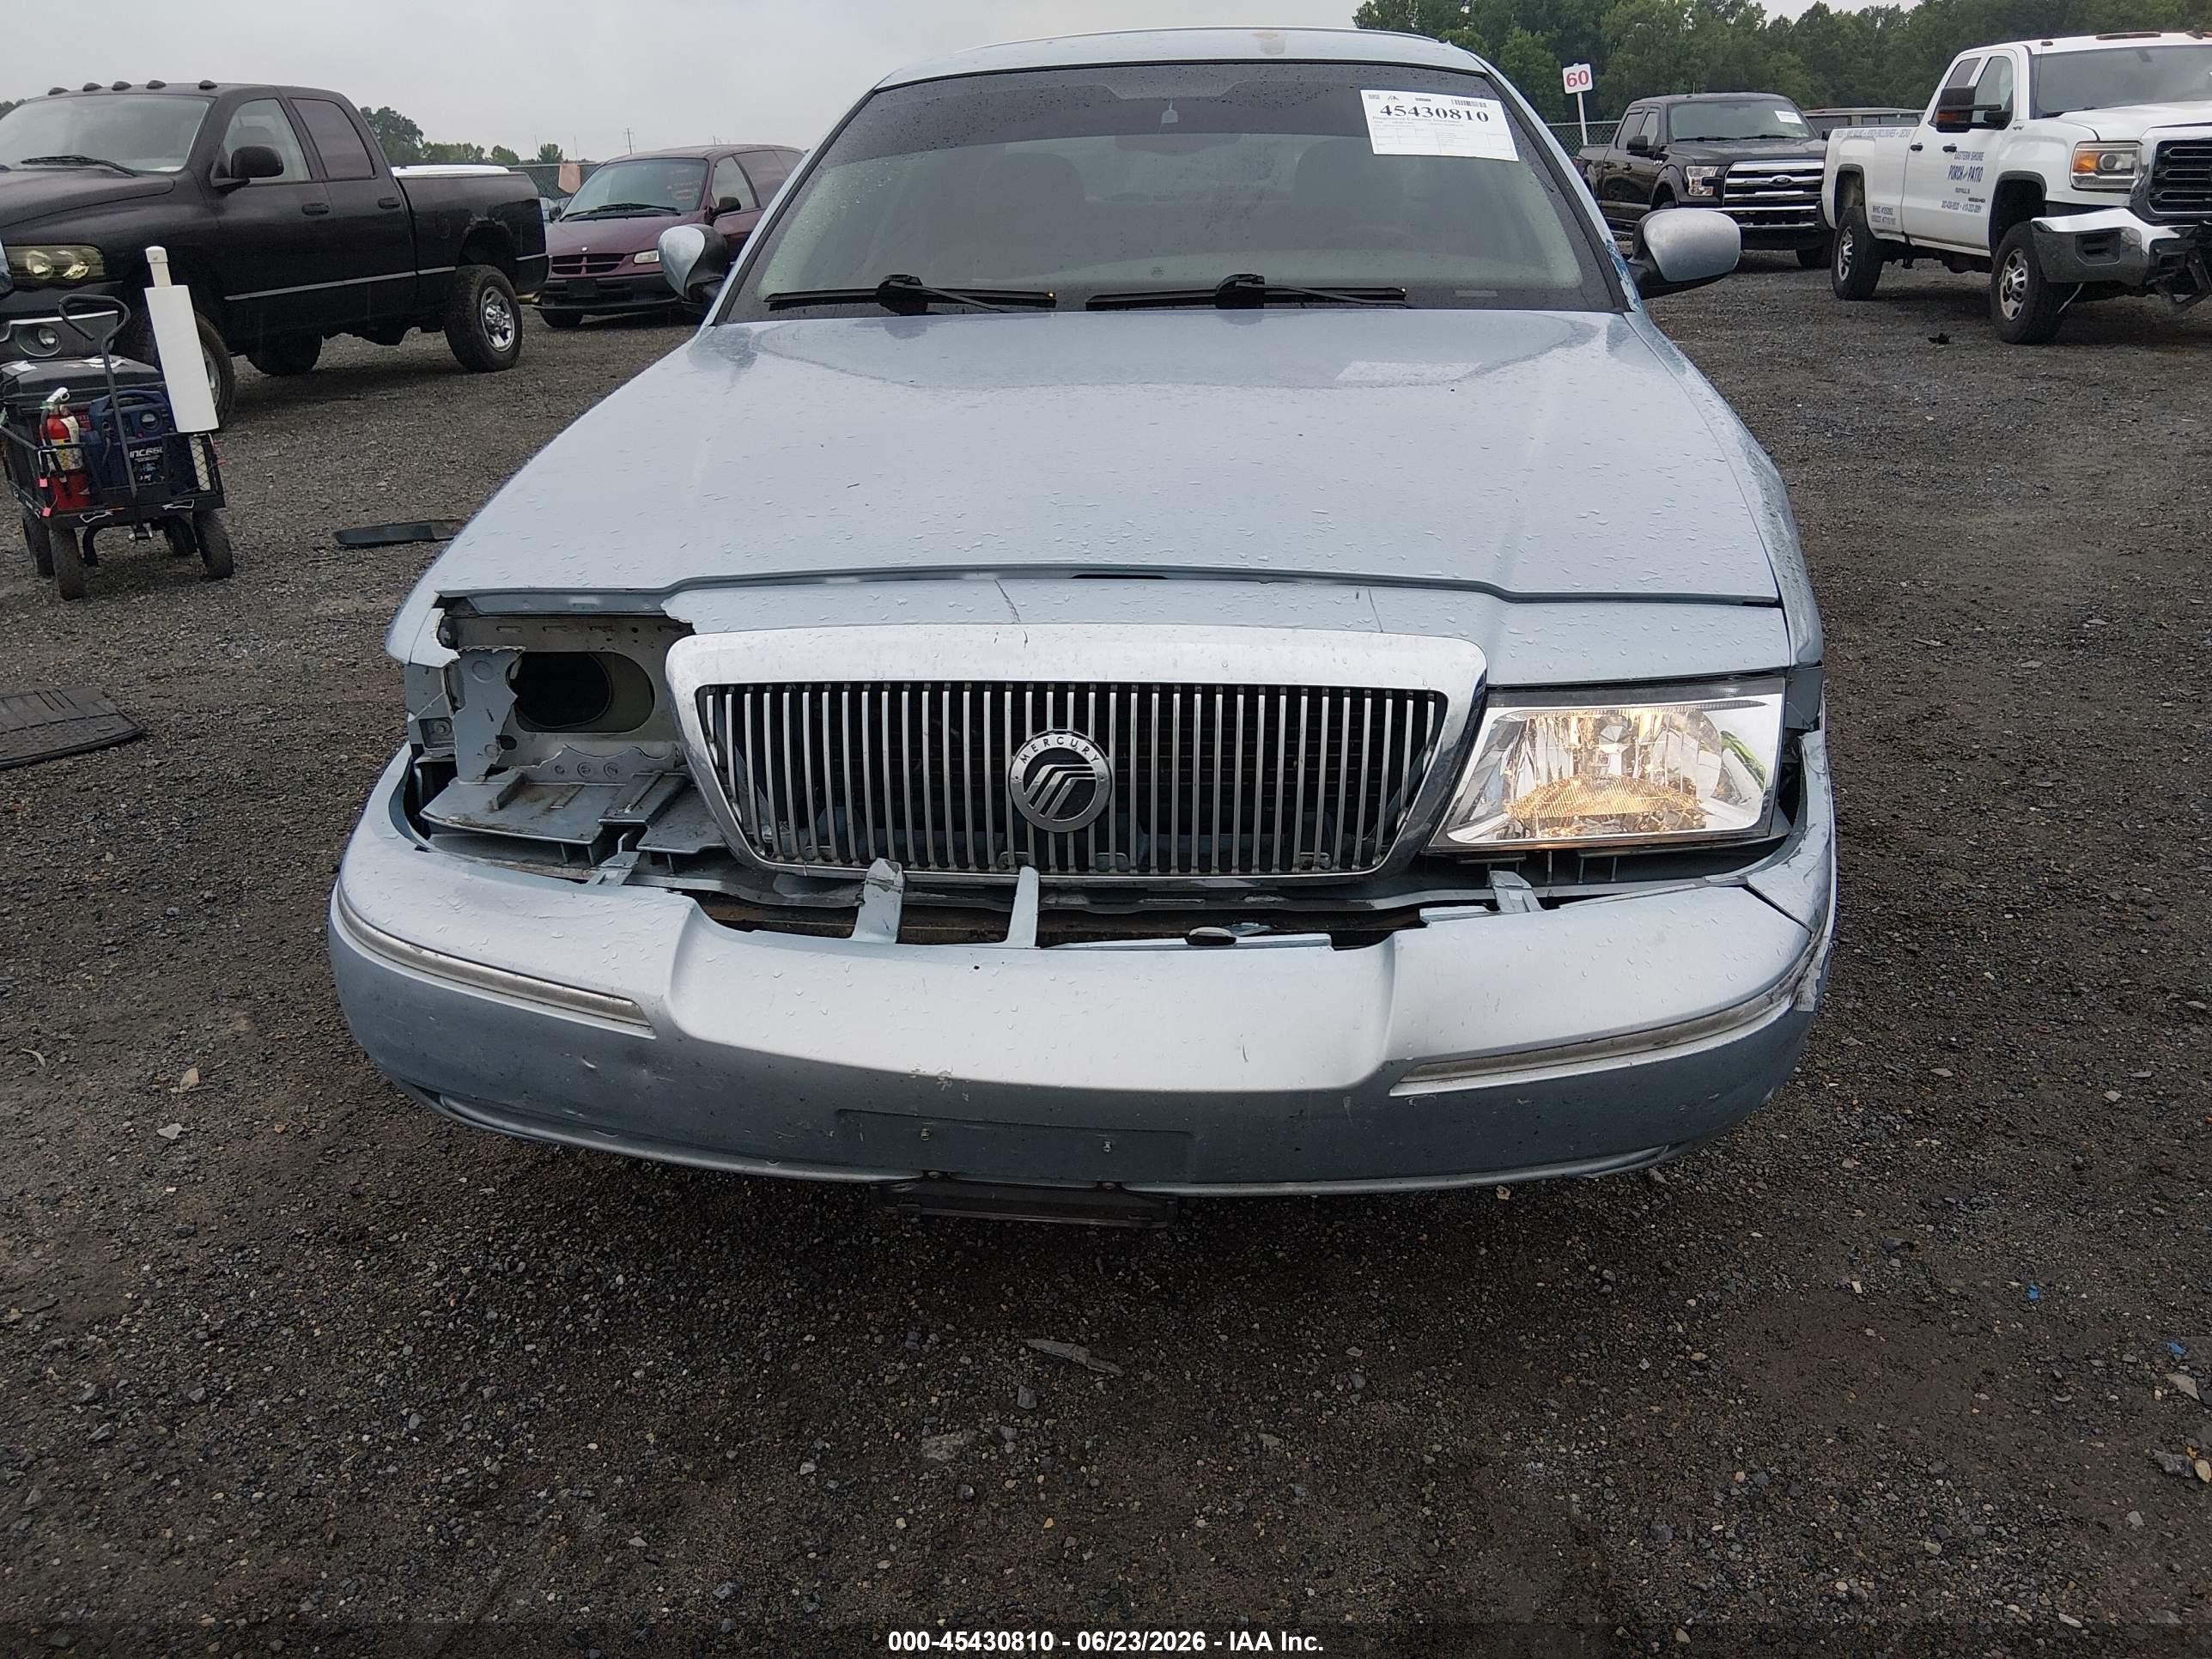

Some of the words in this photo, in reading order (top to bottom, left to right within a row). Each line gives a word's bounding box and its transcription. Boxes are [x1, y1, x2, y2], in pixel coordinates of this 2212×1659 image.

[1566, 70, 1589, 87] 60
[1380, 105, 1489, 123] 45430810
[1967, 165, 1984, 183] PATIO
[1020, 737, 1099, 764] MERCURY
